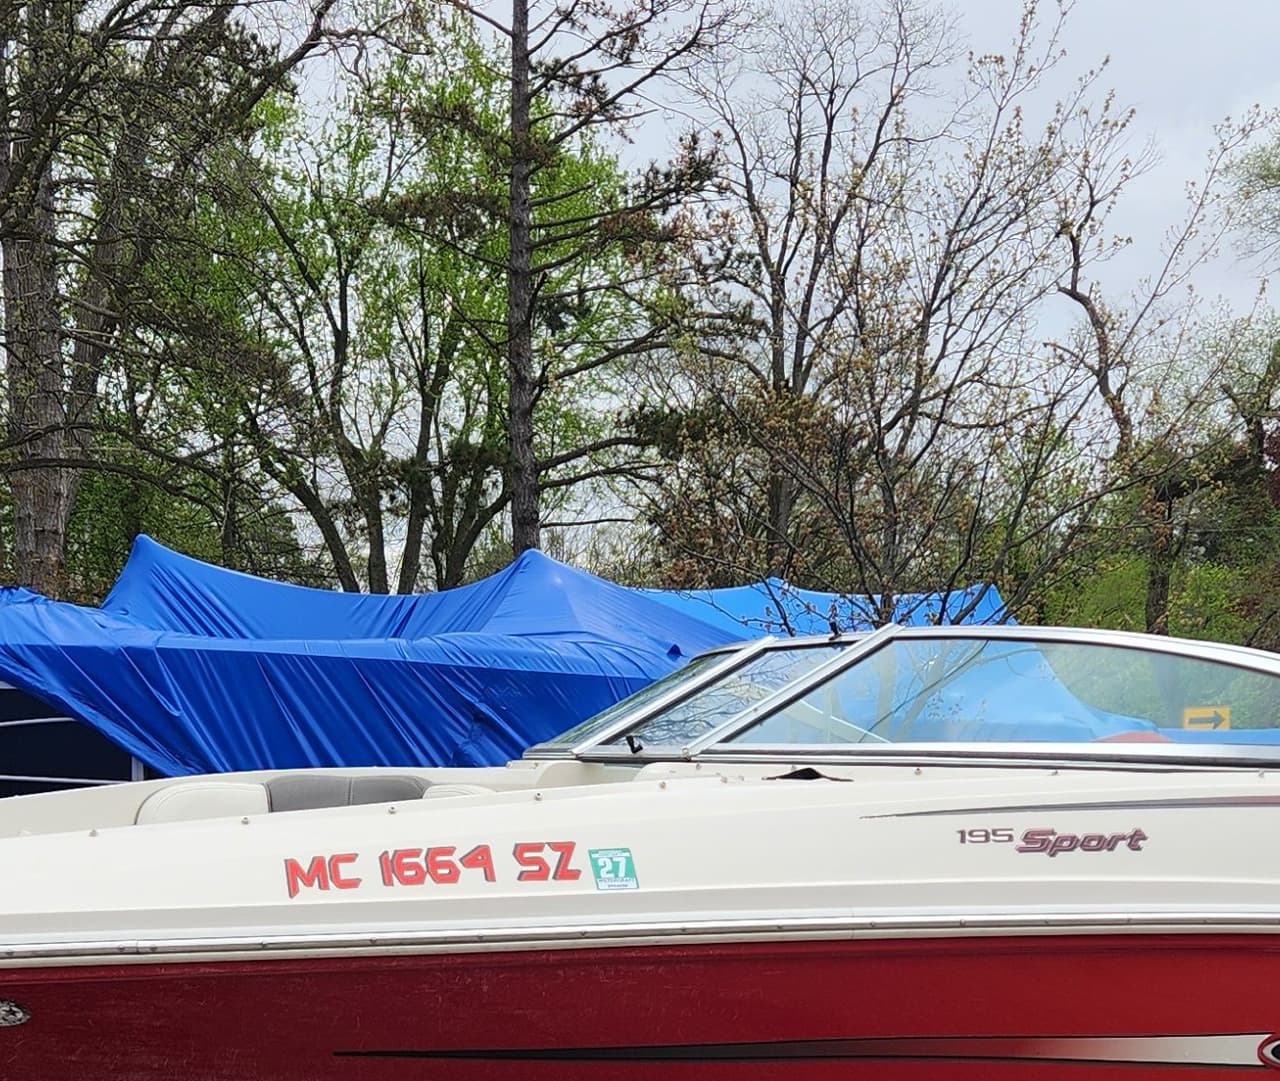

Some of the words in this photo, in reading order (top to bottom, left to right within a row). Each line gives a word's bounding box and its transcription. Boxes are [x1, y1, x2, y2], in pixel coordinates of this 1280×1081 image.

[956, 827, 1015, 844] 195
[1015, 827, 1149, 858] Sport
[284, 852, 362, 899] MC
[378, 844, 497, 887] 1664
[512, 841, 582, 882] SZ
[597, 856, 627, 879] 27
